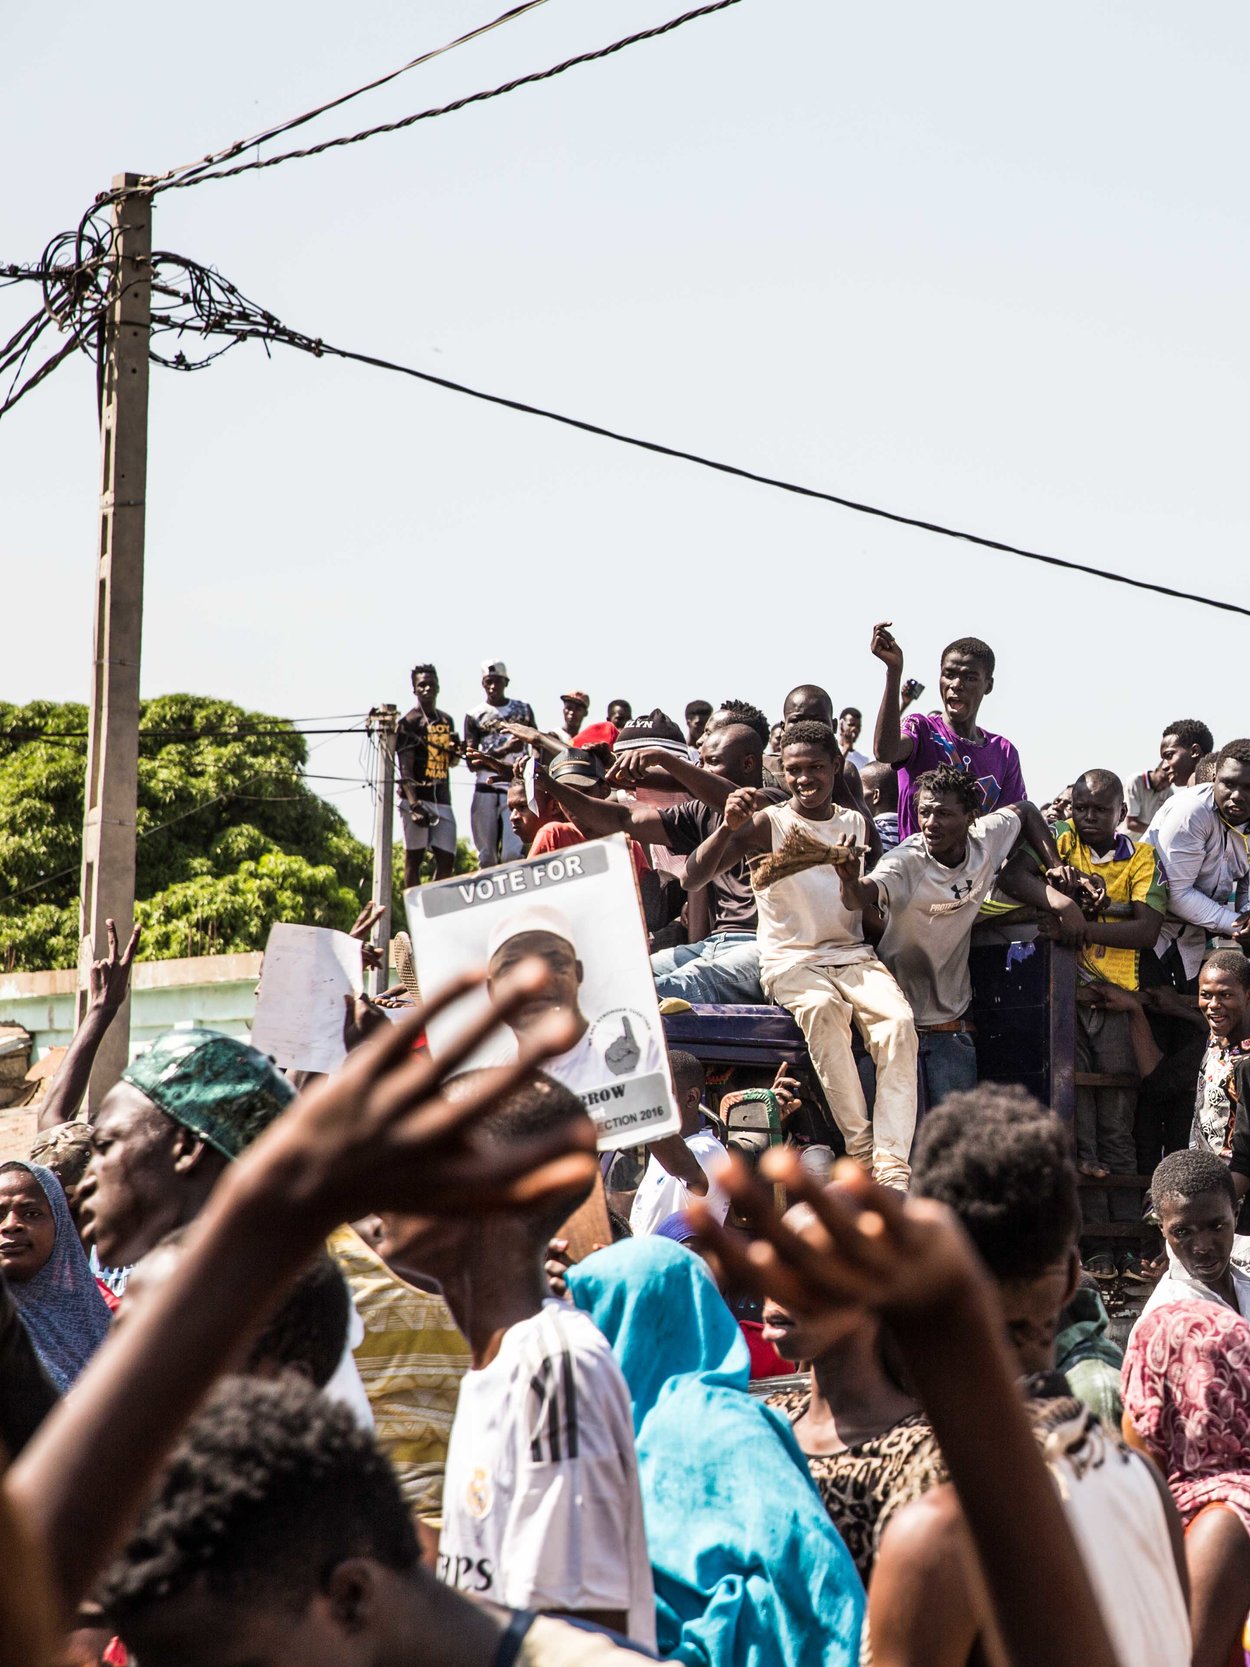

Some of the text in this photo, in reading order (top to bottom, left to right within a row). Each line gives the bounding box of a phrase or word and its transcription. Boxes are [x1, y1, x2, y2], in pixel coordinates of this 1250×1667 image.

[458, 855, 585, 904] VOTE FOR
[581, 1084, 625, 1106] ROW
[597, 1105, 664, 1132] ECTION 2016
